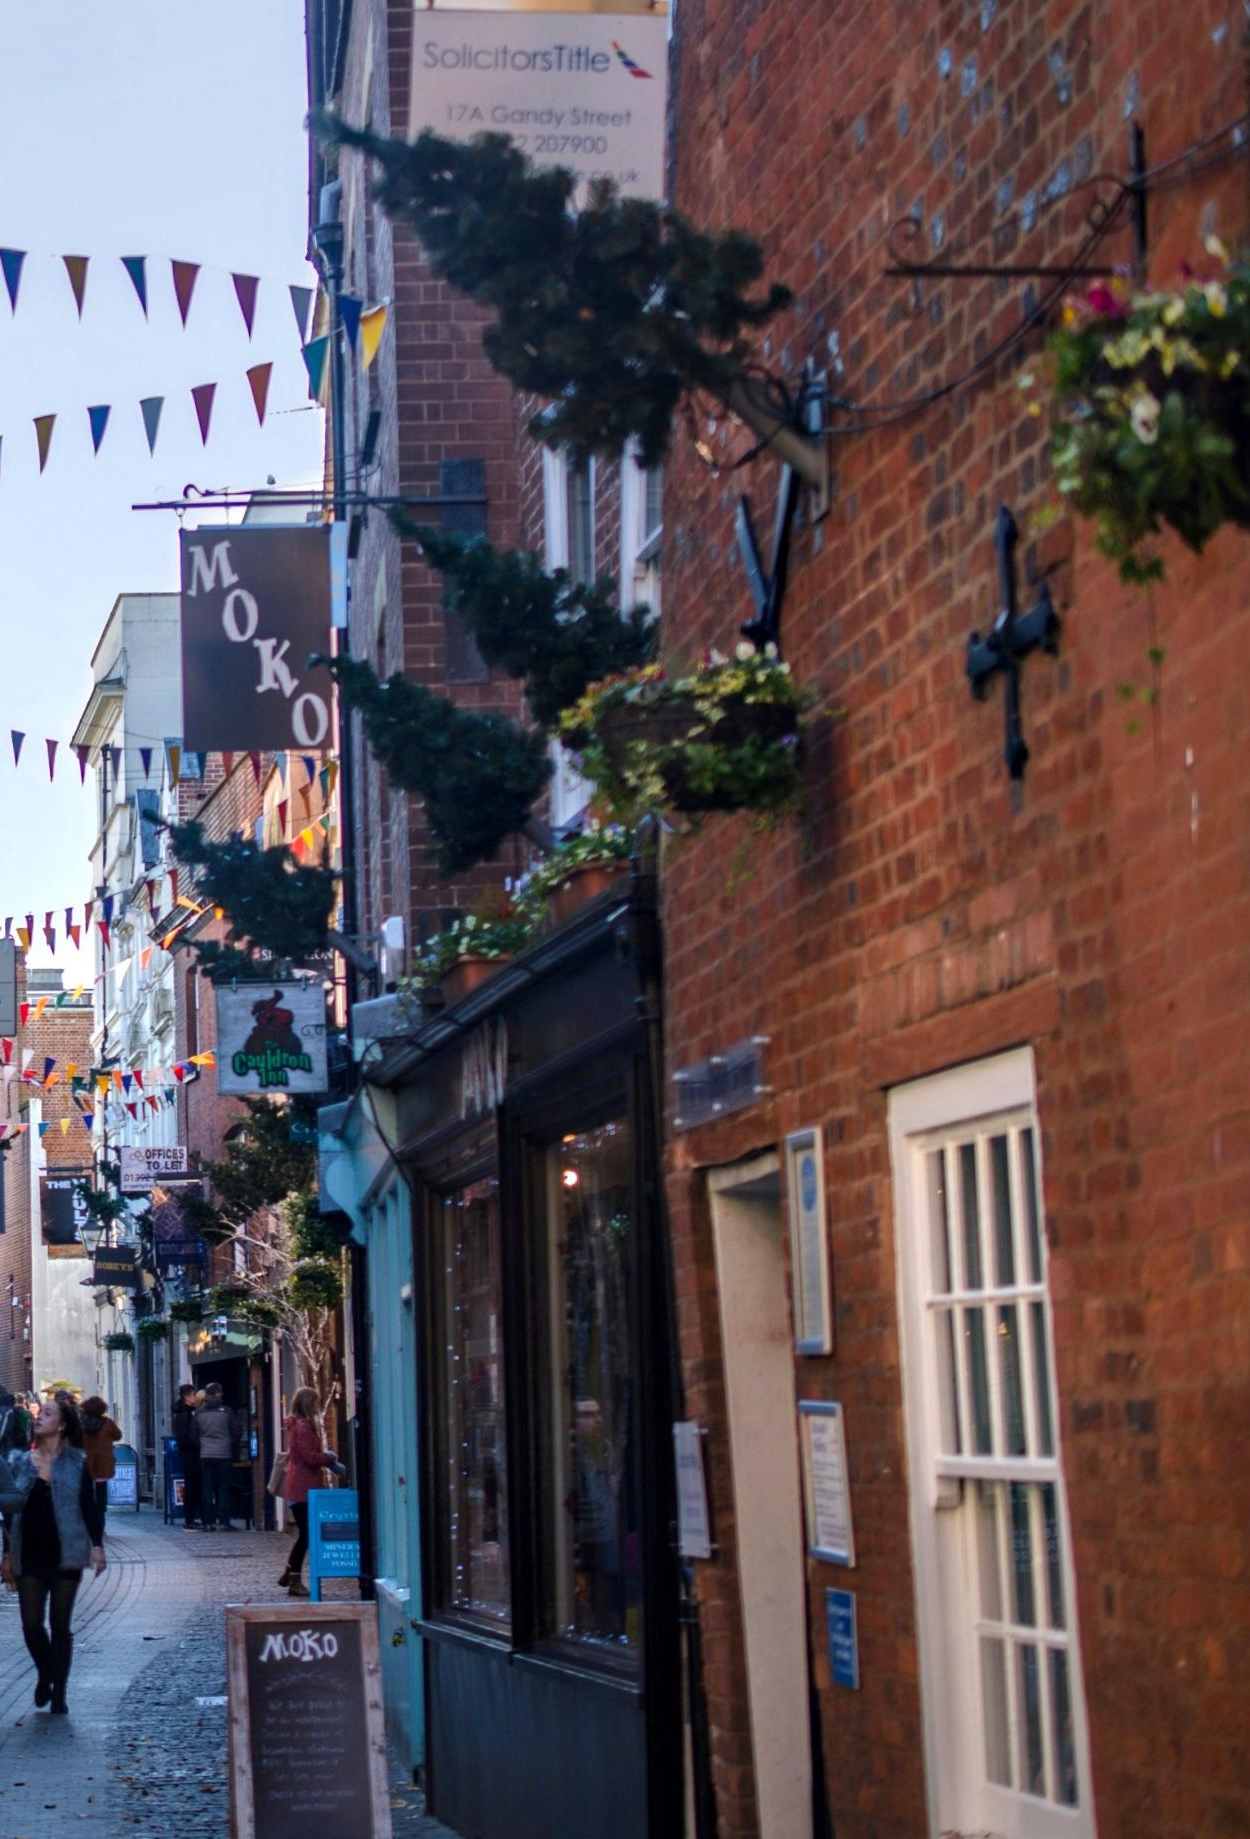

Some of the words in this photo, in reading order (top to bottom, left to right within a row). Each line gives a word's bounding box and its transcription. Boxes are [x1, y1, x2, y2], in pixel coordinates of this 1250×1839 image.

[424, 42, 610, 73] SolicitorsTitle
[446, 105, 486, 122] 17A
[491, 107, 564, 128] Gandy
[571, 107, 631, 125] Street
[535, 136, 608, 154] 207900
[186, 540, 328, 746] MOKO
[233, 1050, 312, 1075] Cauldron
[259, 1068, 288, 1087] Inn
[145, 1148, 184, 1159] OFFICES
[146, 1161, 159, 1170] TO
[165, 1161, 183, 1170] LET
[46, 1180, 71, 1188] THE
[259, 1630, 338, 1663] MOKO
